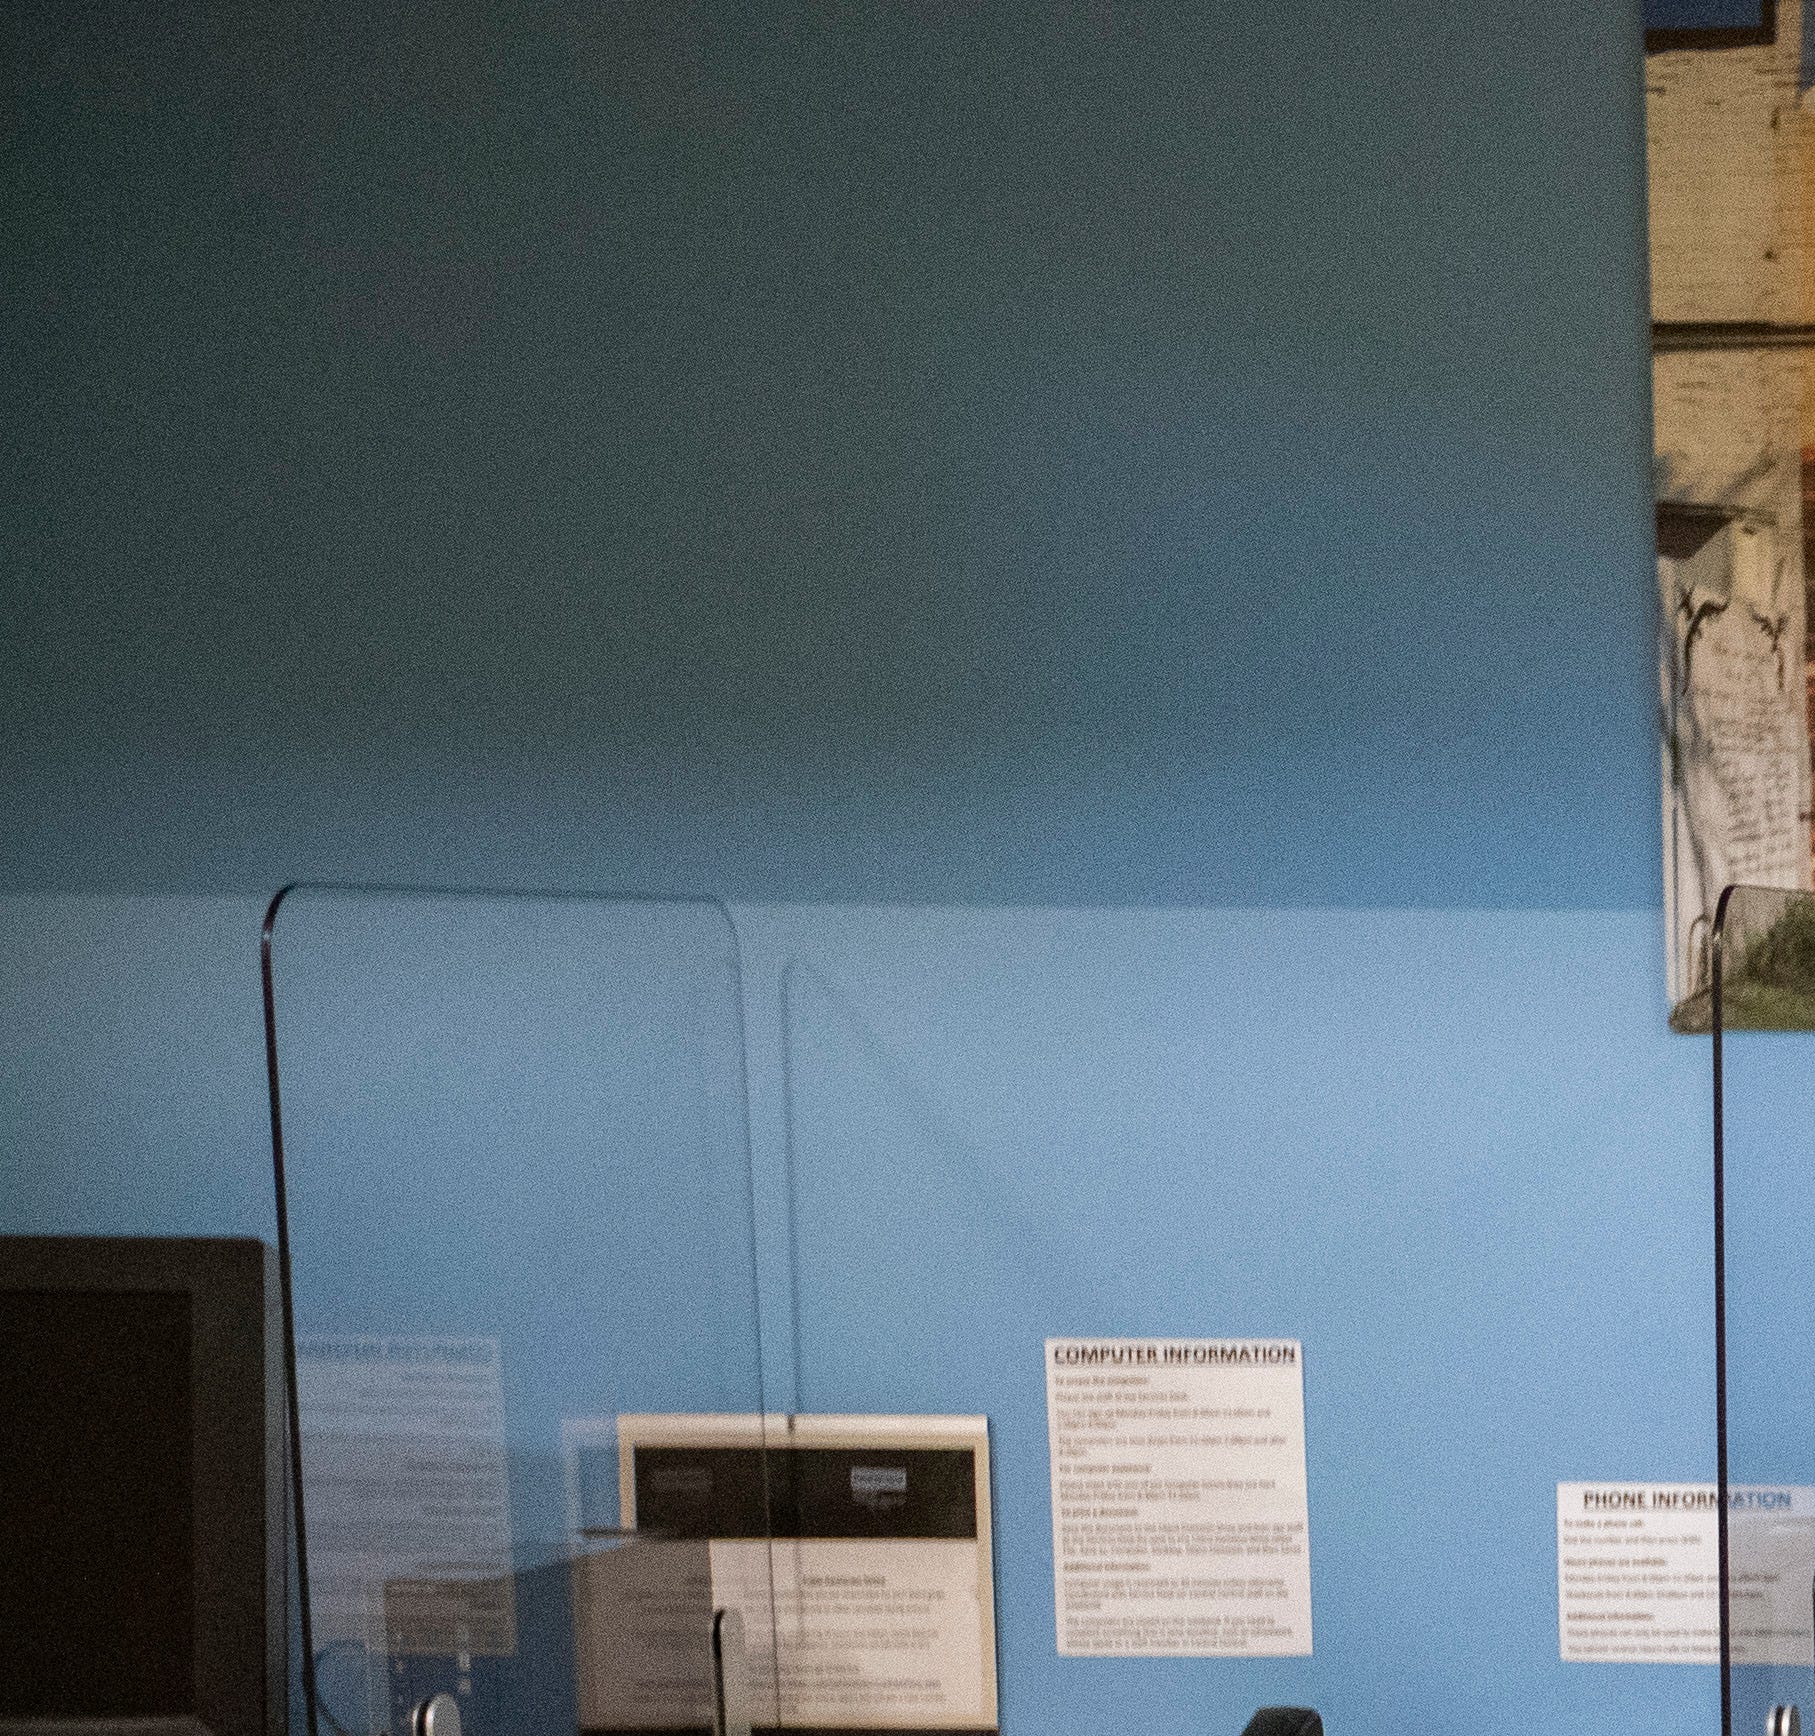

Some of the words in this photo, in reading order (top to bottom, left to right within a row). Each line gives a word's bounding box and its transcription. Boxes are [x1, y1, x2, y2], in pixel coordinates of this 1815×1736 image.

[1054, 1345, 1160, 1365] COMPUTER
[1163, 1345, 1296, 1365] INFORMATION
[1583, 1490, 1646, 1511] PHONE
